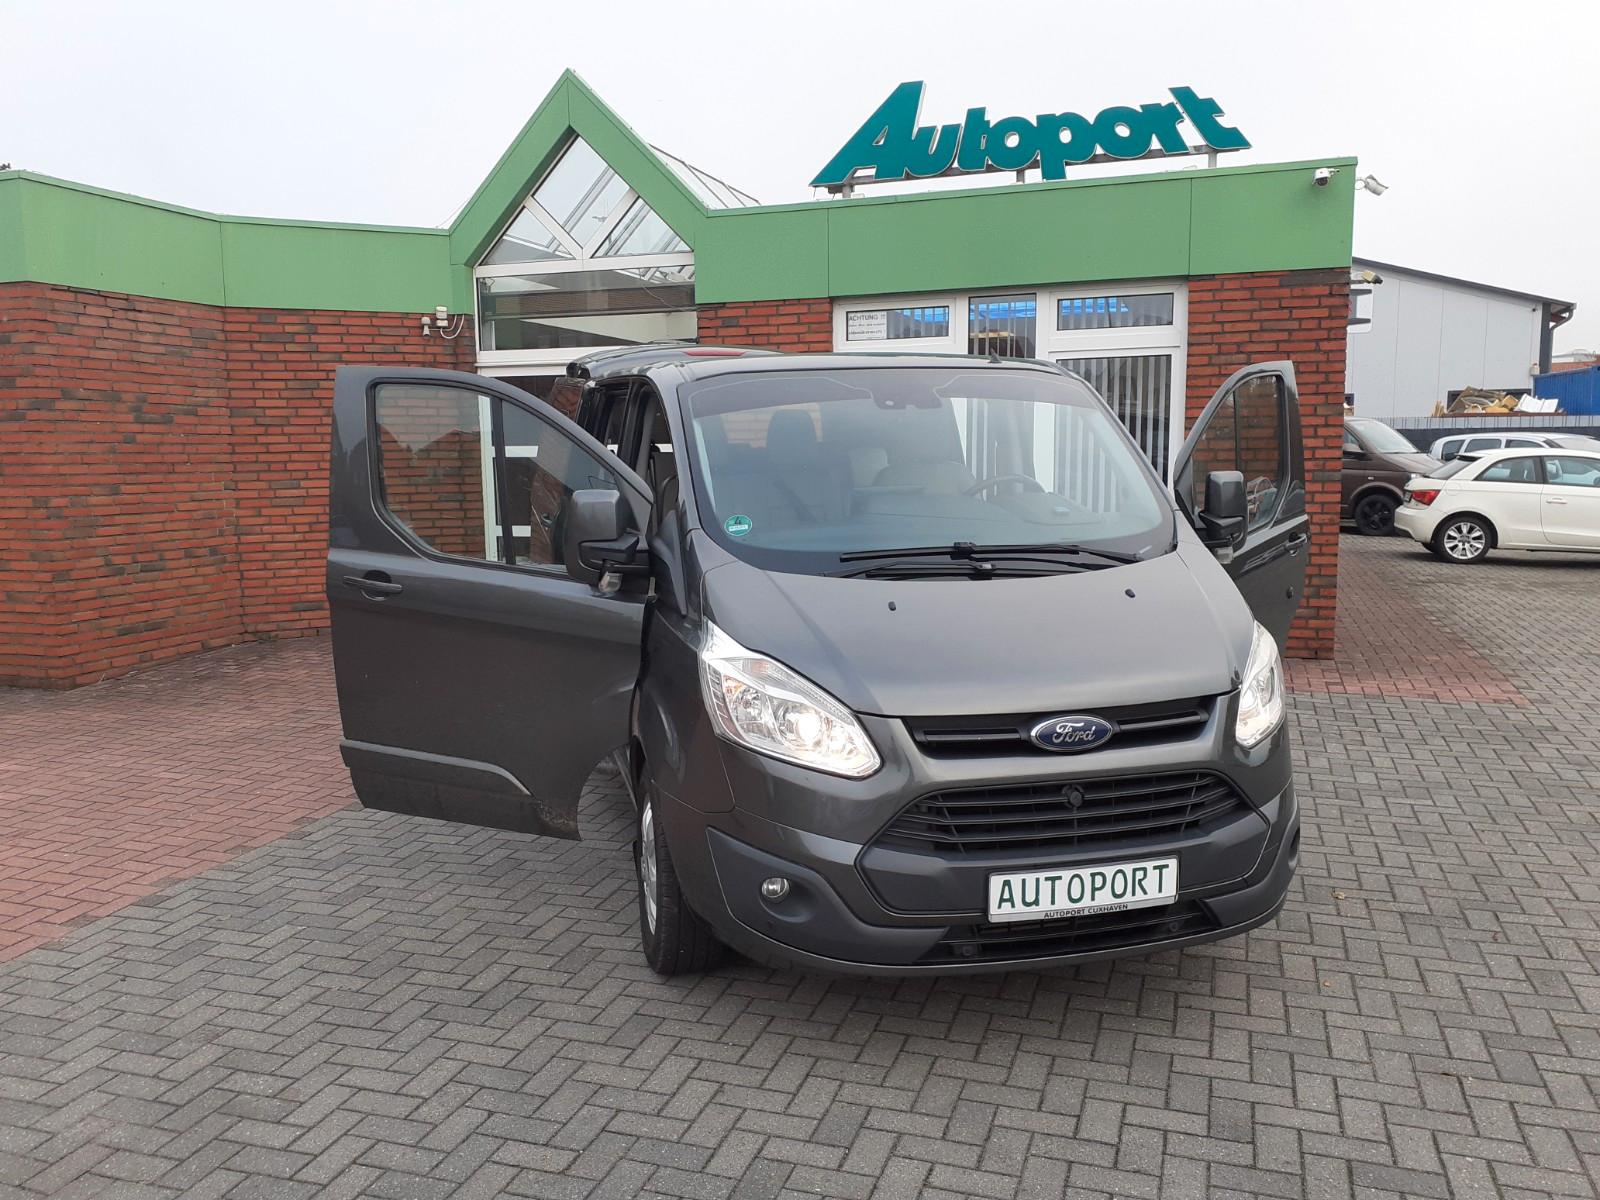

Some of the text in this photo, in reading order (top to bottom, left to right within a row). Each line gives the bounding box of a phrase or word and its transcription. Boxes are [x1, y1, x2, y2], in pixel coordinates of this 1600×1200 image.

[808, 80, 1251, 187] Autoport
[848, 314, 878, 322] ACHTUNG
[1052, 722, 1096, 744] Ford
[997, 863, 1170, 910] AUTOPORT
[1043, 904, 1128, 919] AUTOPORT CUXHAVEN
